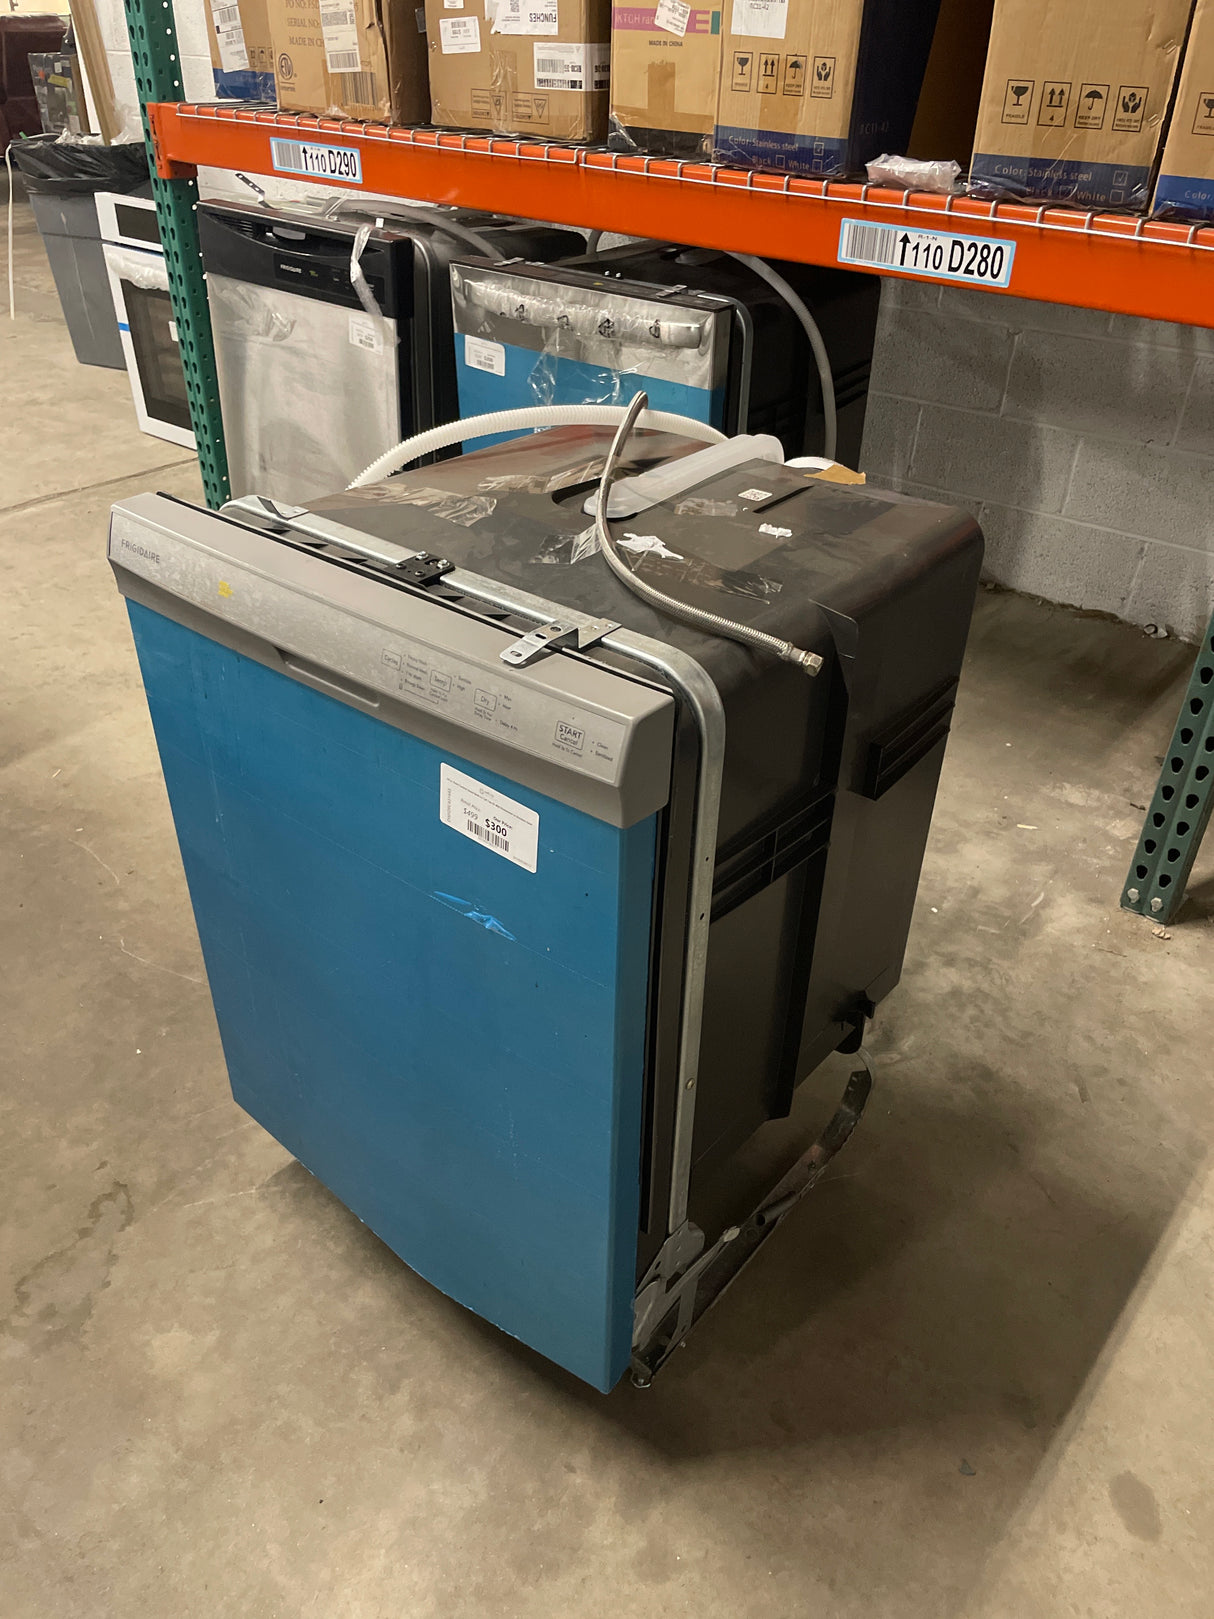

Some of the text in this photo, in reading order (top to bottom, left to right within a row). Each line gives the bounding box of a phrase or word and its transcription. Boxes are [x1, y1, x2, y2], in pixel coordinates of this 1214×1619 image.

[287, 17, 307, 28] SERIAL
[529, 12, 557, 23] FUNCHES
[289, 36, 307, 47] MADE
[307, 37, 315, 47] IN
[752, 138, 780, 149] Stainless
[781, 142, 799, 152] steel
[309, 149, 357, 178] 110 D290
[787, 159, 810, 170] White
[1028, 167, 1068, 180] Stainless
[1070, 171, 1093, 181] steel
[1075, 189, 1106, 201] White
[911, 239, 1005, 280] 110 D280
[120, 537, 161, 564] FRIGIDAIRE
[480, 695, 490, 707] Dry
[558, 724, 583, 740] START
[559, 733, 579, 747] Cancel
[463, 806, 479, 821] $499
[484, 817, 508, 838] $300
